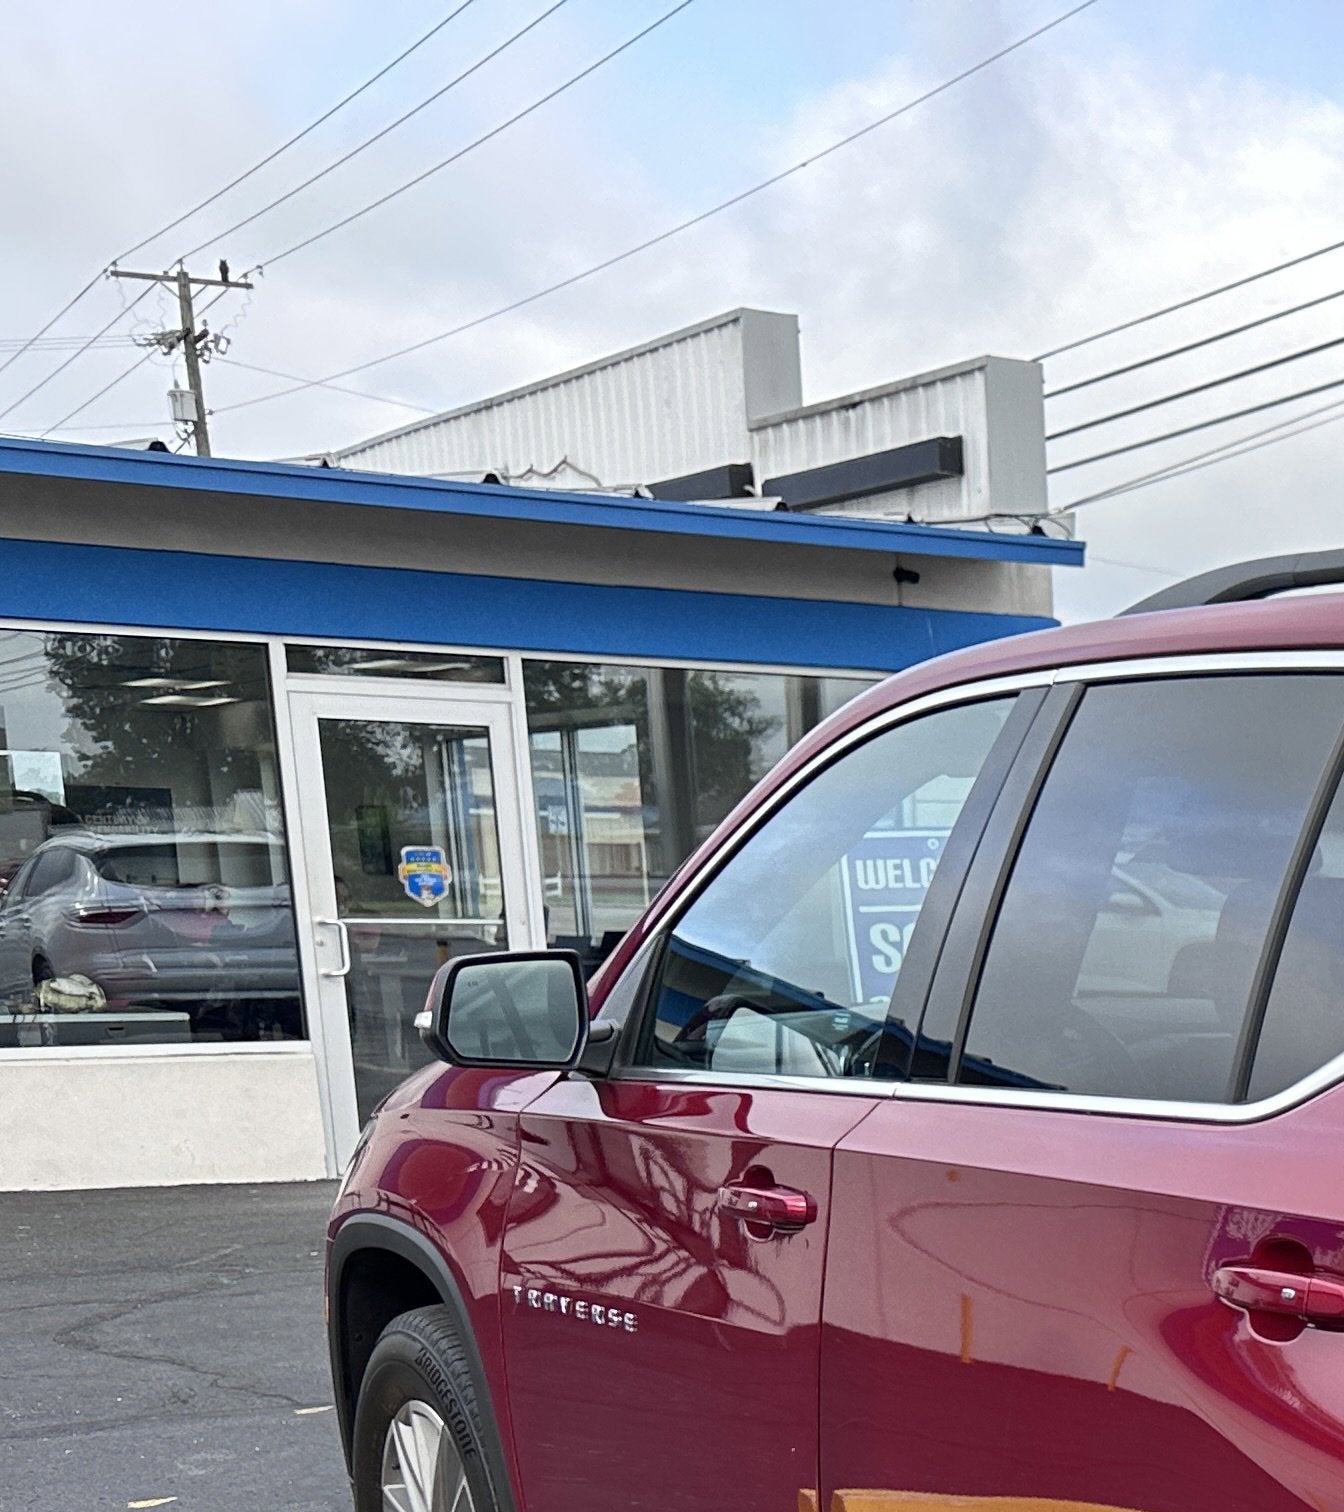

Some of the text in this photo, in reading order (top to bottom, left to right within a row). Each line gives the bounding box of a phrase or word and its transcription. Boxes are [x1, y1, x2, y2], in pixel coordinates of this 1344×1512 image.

[855, 857, 939, 889] WELC
[512, 1285, 639, 1333] TRAVERSE
[415, 1346, 477, 1460] BRIDGESTONE
